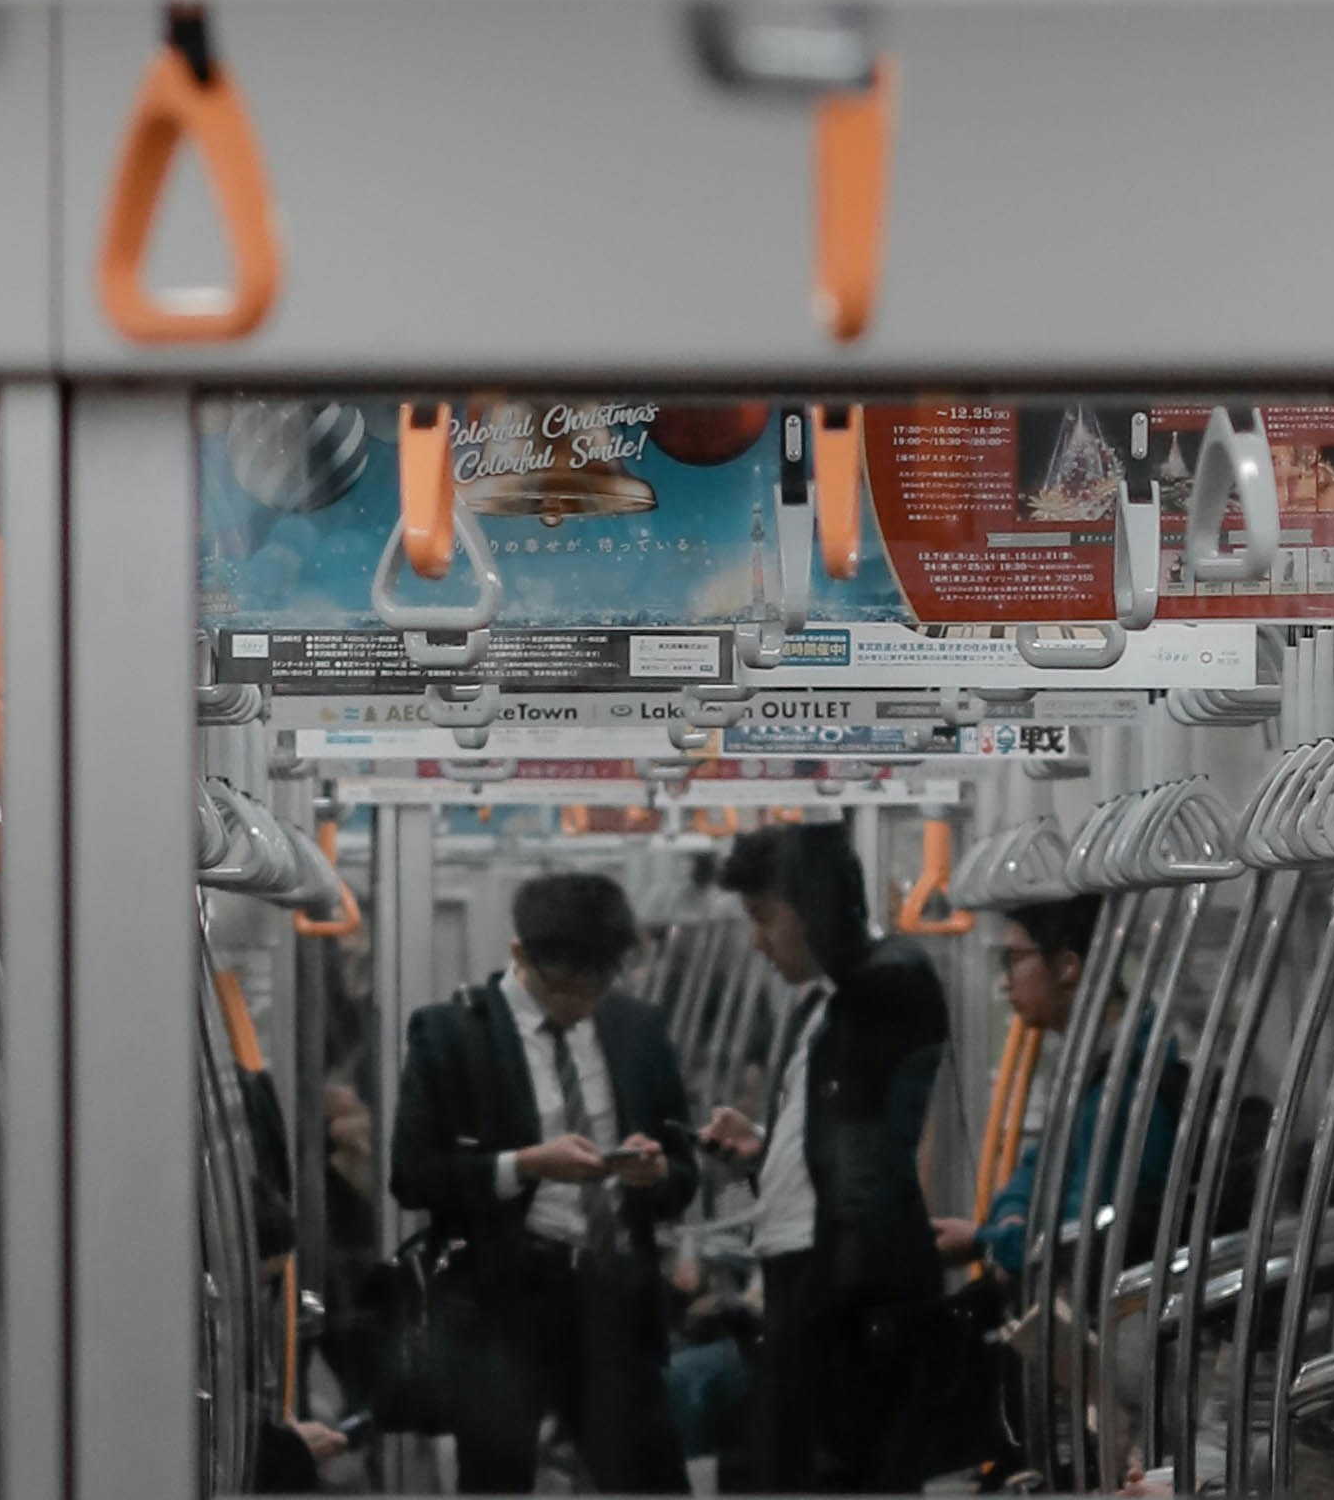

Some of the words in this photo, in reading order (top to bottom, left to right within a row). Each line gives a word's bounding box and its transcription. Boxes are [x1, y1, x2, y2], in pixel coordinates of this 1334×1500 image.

[449, 411, 535, 449] Colorful
[542, 403, 660, 439] Christmas
[454, 442, 556, 484] Colorful
[569, 431, 649, 470] Smile!
[762, 701, 852, 719] OUTLET
